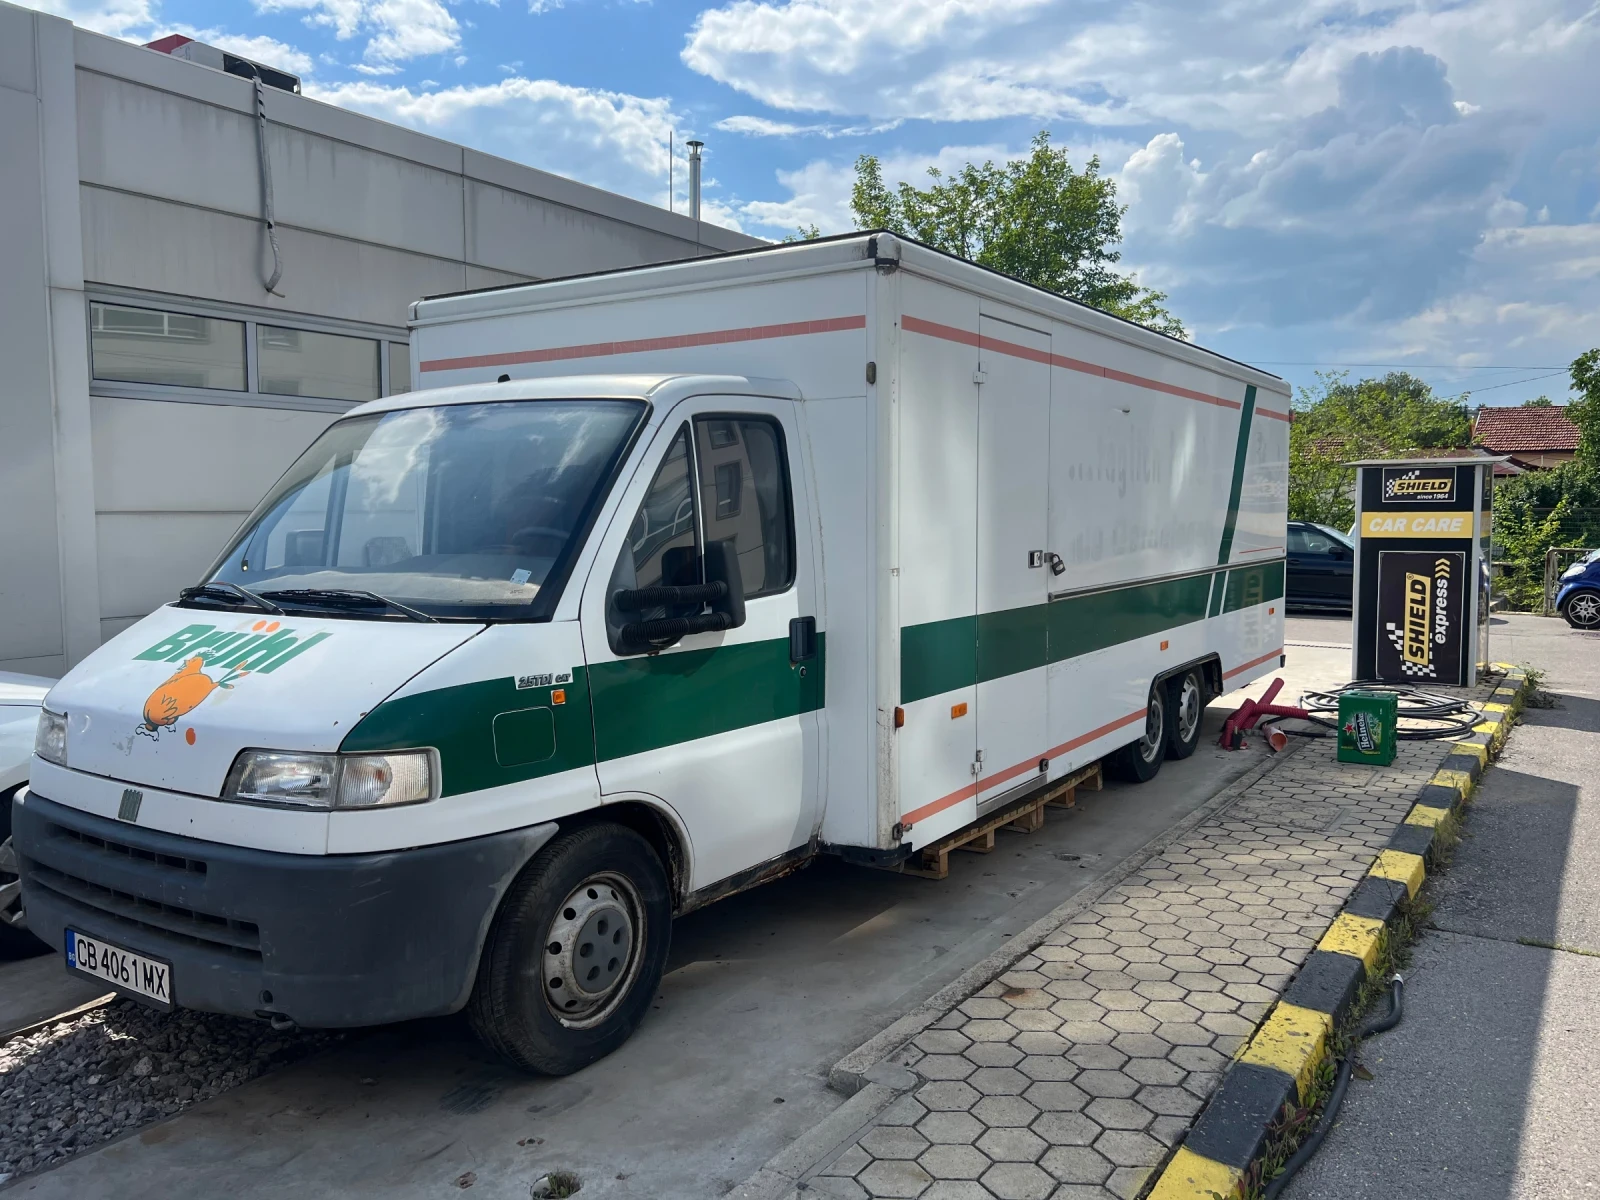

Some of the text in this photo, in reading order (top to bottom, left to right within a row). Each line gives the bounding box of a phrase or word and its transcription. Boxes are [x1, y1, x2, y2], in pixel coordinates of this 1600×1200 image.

[1397, 481, 1448, 491] SHIELD
[1369, 517, 1407, 532] CAR
[1411, 517, 1464, 532] CARE
[1408, 579, 1427, 659] SHIELD
[1435, 578, 1449, 645] express
[77, 939, 167, 998] CB 4061 MX
